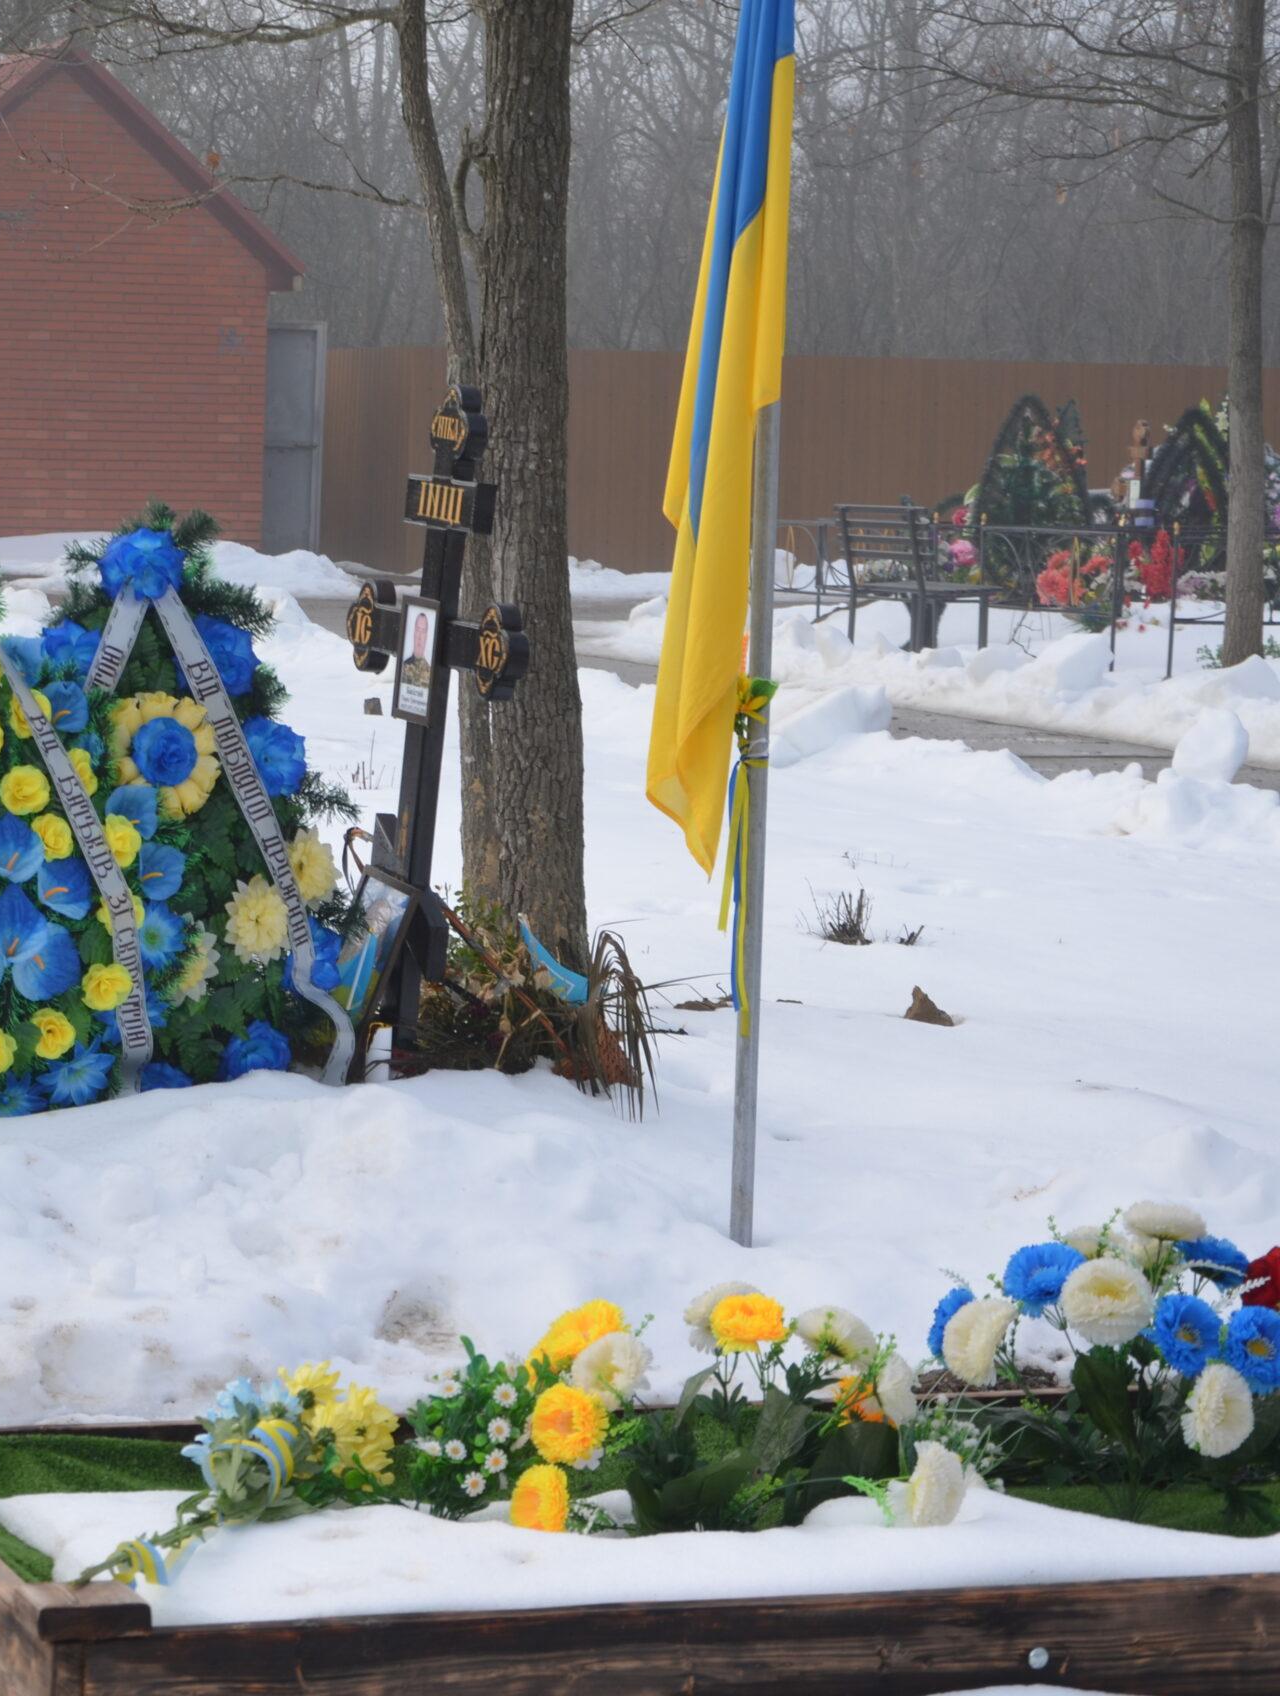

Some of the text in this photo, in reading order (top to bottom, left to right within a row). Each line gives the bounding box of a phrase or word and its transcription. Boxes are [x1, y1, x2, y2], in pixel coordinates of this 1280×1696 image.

[30, 714, 60, 754] ВІД
[58, 775, 114, 879] БАТЬКІВ
[108, 892, 134, 917] ЗІ
[186, 658, 309, 948] ВІД ЛЮБЛЯЧОЇ ДРУЖИНИ
